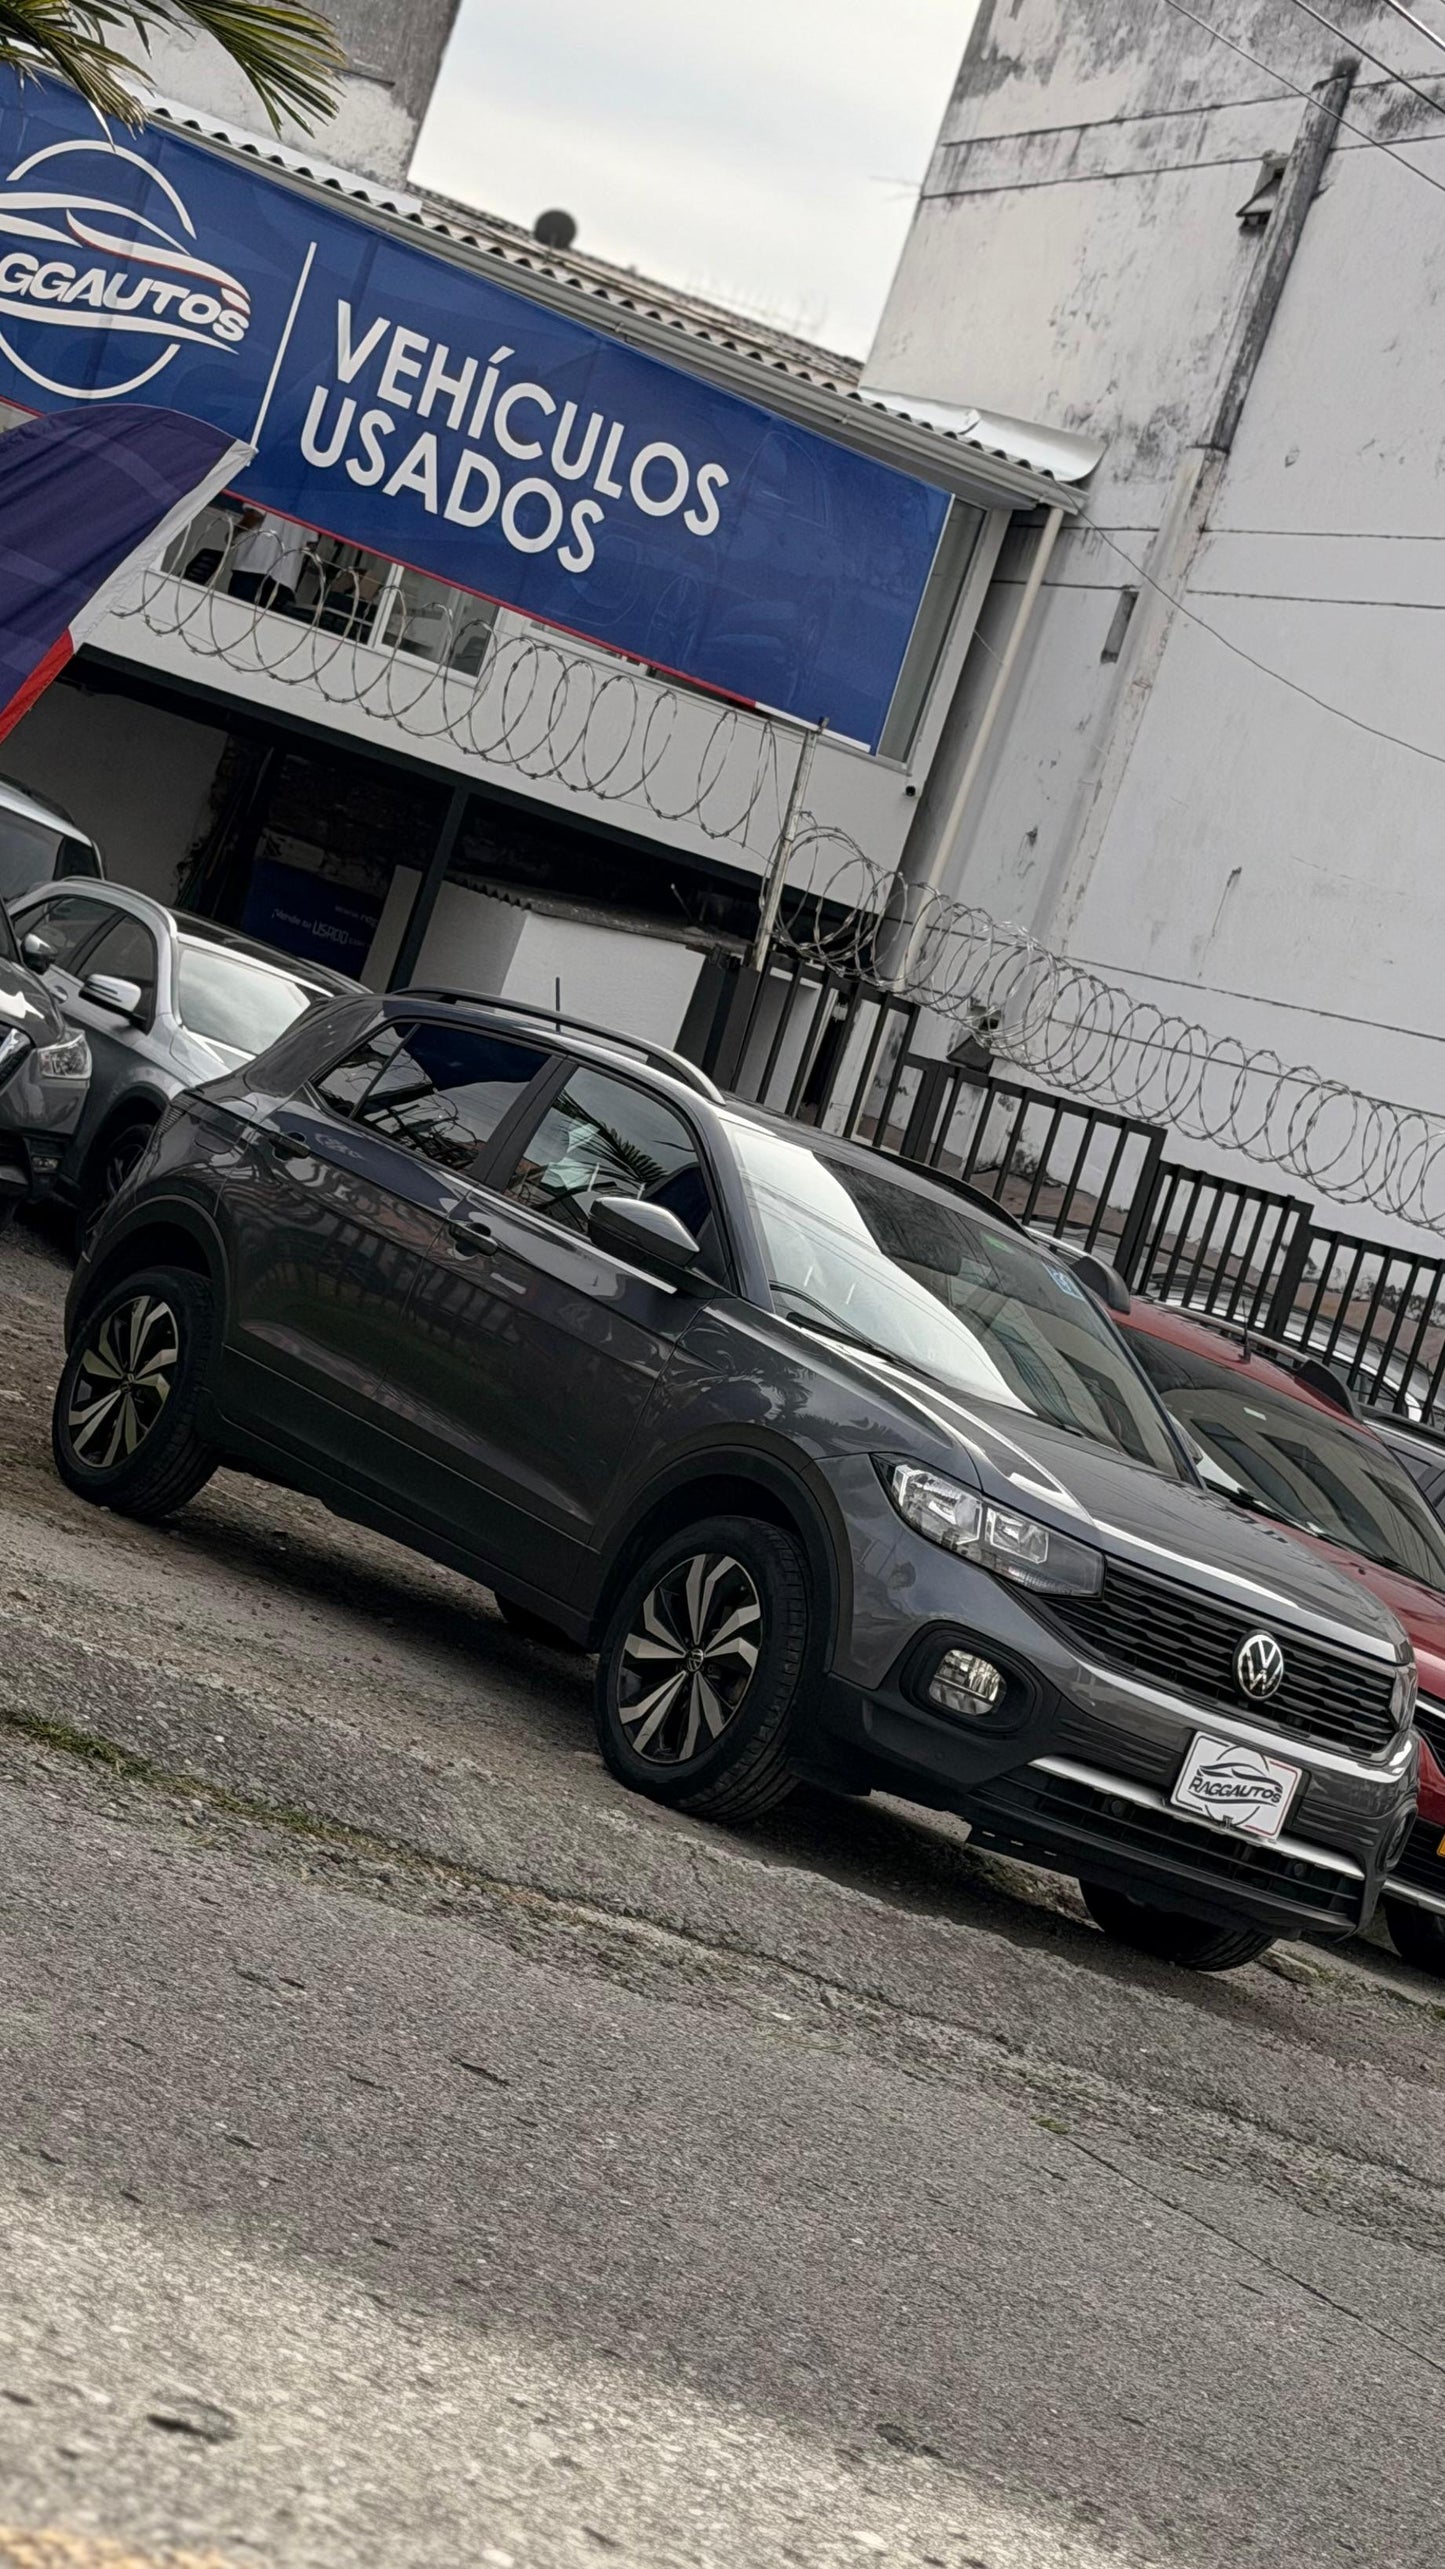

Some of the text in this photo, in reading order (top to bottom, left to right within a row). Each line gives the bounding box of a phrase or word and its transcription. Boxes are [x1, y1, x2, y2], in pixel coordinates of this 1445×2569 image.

[338, 299, 729, 536] VEHÍCULOS
[301, 385, 605, 573] USADOS
[312, 920, 349, 944] USADO
[1188, 1776, 1282, 1803] RAGGAUTOS
